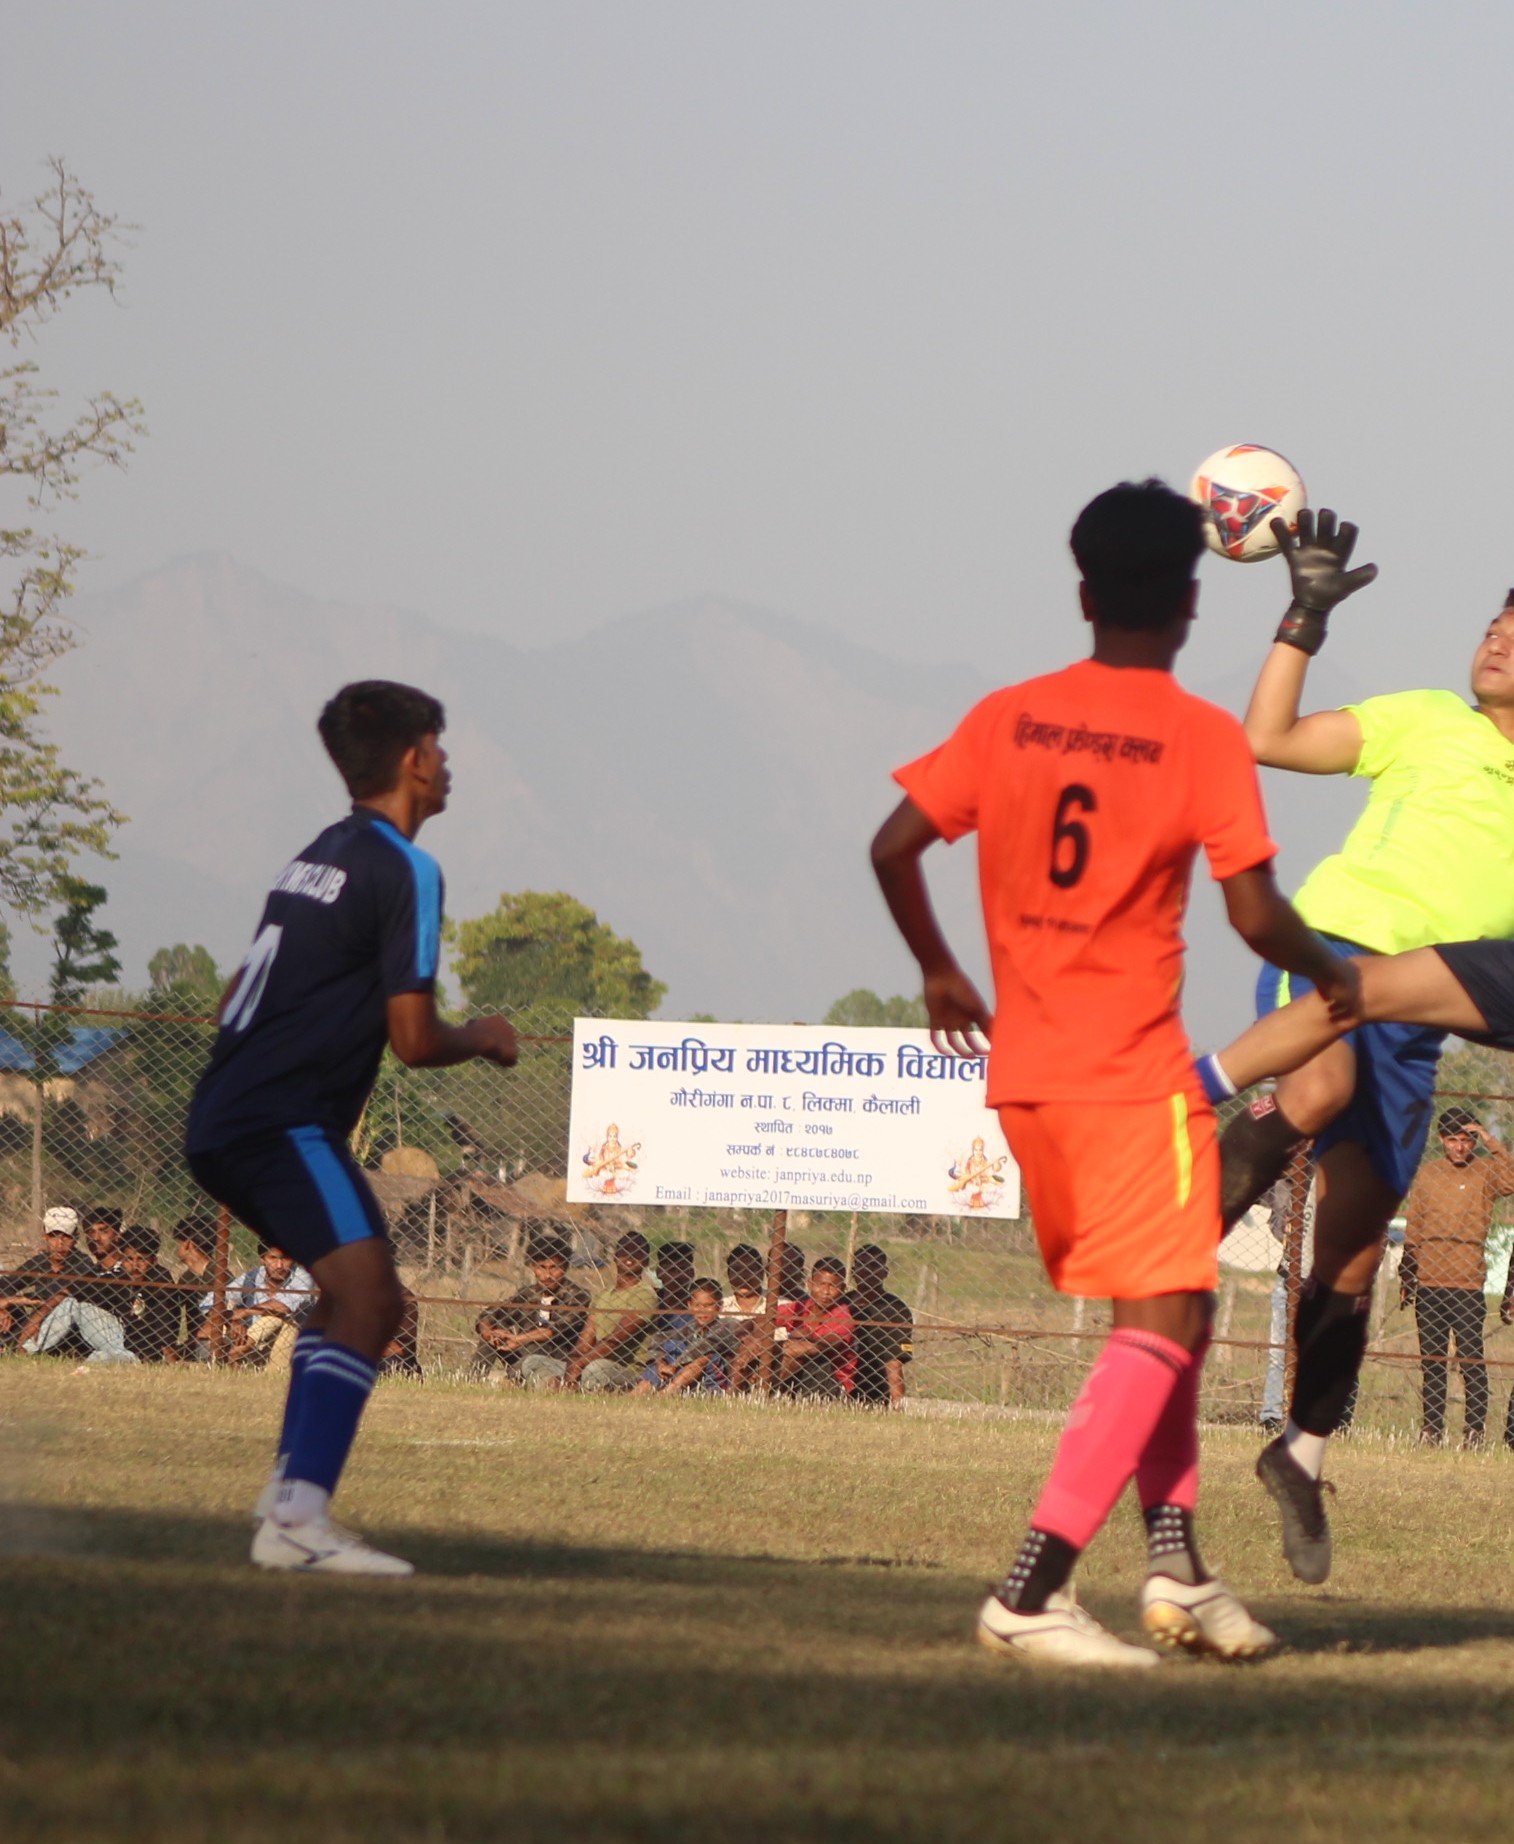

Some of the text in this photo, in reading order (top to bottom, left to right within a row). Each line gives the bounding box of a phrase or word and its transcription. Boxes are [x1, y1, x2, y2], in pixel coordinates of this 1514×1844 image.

[1049, 783, 1098, 888] 6
[582, 1035, 989, 1081] श्री जनप्रिय माध्यमिक विद्याल
[670, 1087, 735, 1108] गौरीगंगा
[862, 1093, 921, 1115] कैलाली
[754, 1119, 794, 1134] स्थापित
[804, 1124, 834, 1136] २०१७
[726, 1143, 762, 1156] सम्पर्क
[720, 1166, 873, 1187] website: janpriya.edu.np
[655, 1185, 692, 1201] Email
[703, 1187, 928, 1210] janapriya2017masuriya@gmail.com
